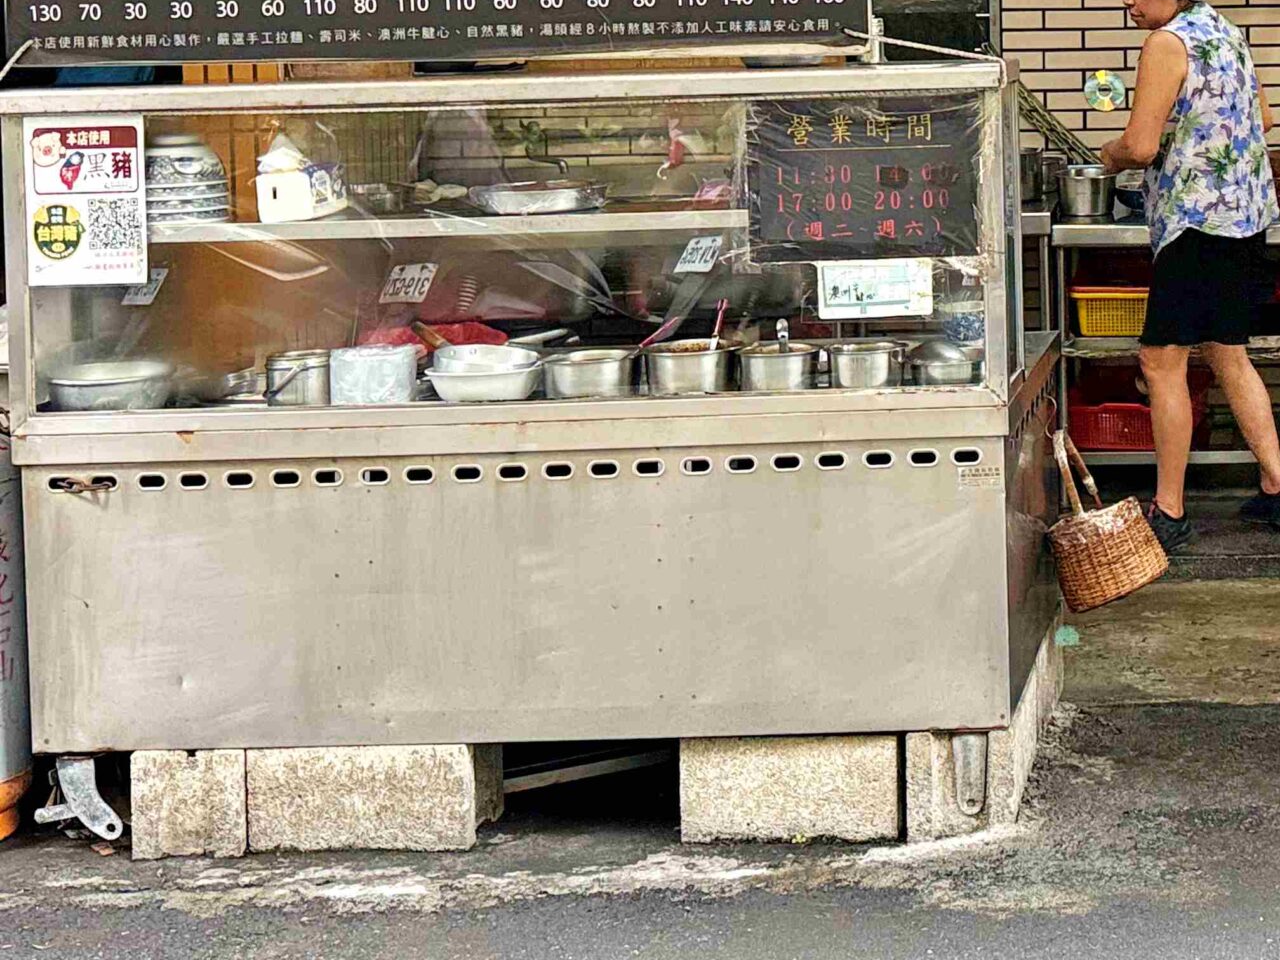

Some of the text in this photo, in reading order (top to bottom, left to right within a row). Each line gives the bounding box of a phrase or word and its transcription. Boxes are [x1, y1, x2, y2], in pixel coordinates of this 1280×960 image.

[29, 4, 62, 22] 130
[78, 3, 102, 21] 70
[124, 2, 147, 20] 30
[170, 1, 193, 19] 30
[216, 0, 239, 18] 30
[261, 0, 285, 17] 60
[66, 130, 110, 146] 本店使用
[787, 113, 933, 145] 營業時間
